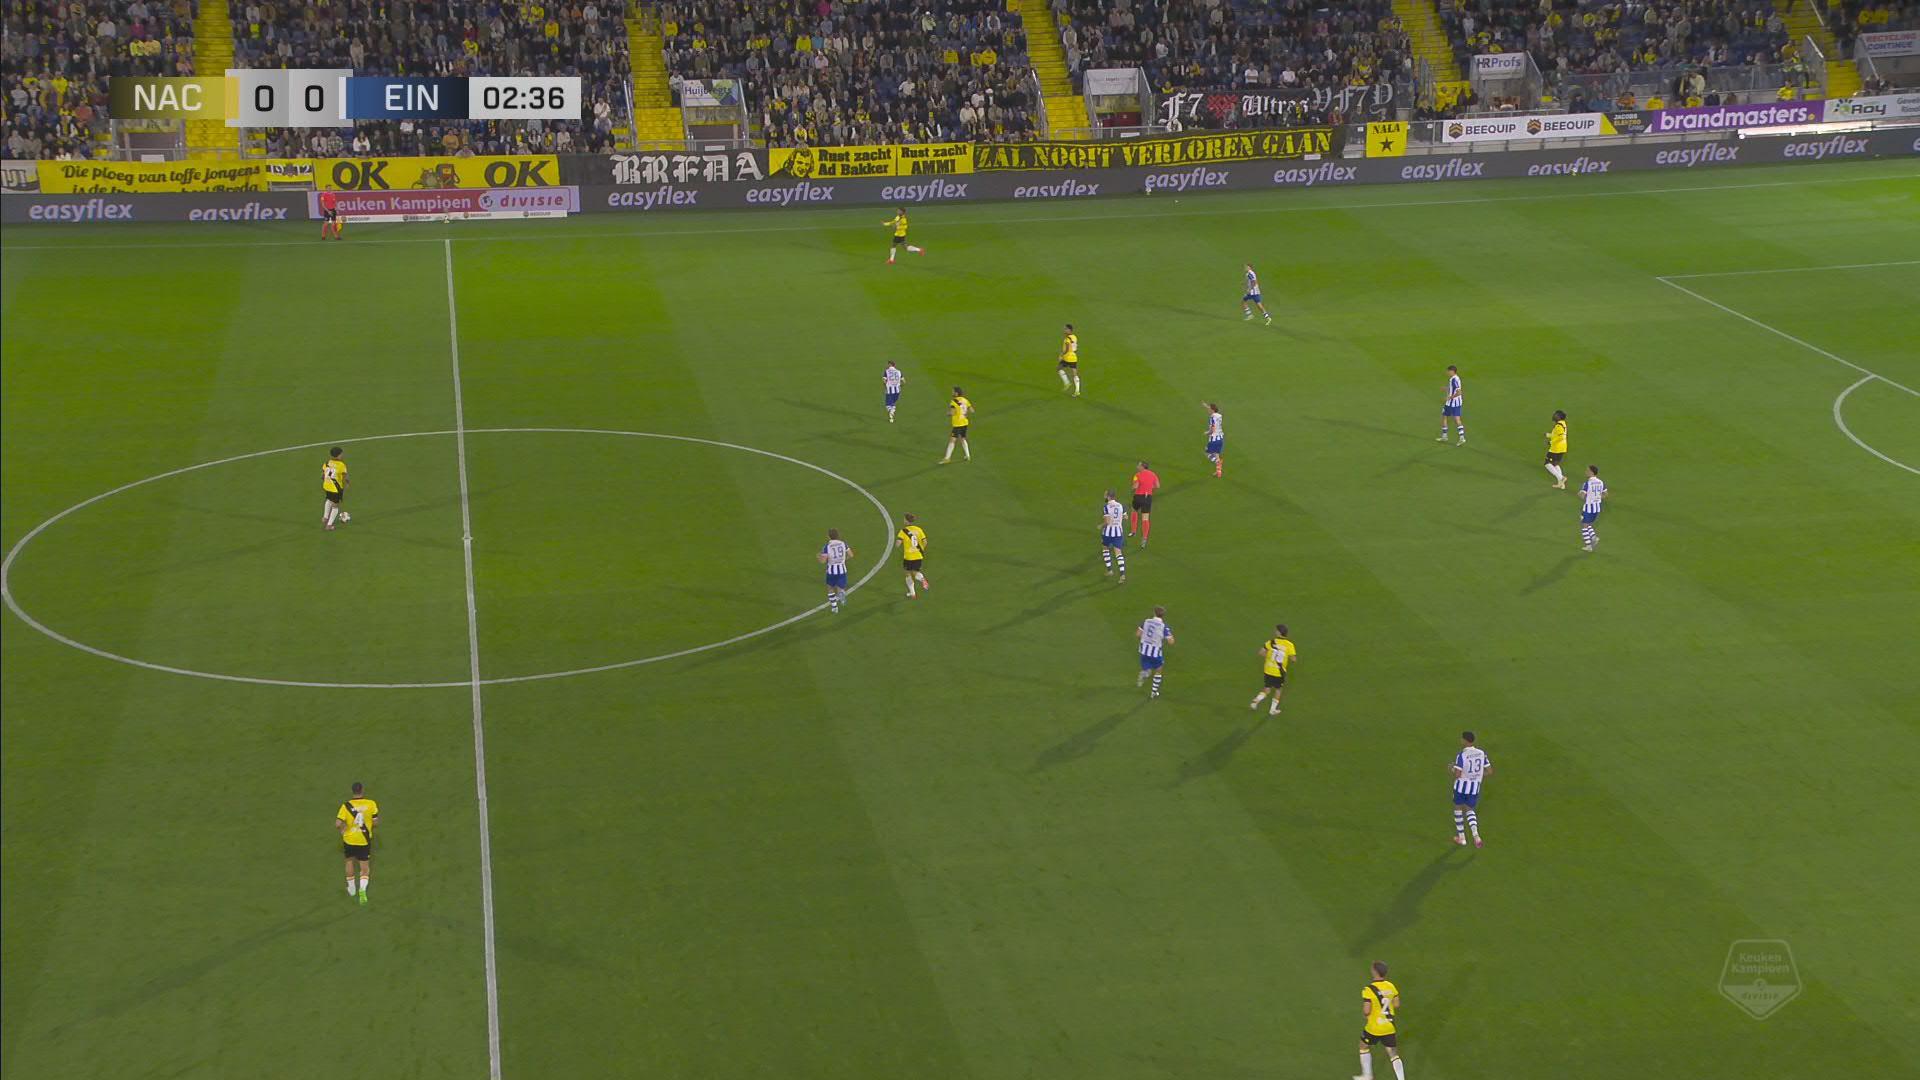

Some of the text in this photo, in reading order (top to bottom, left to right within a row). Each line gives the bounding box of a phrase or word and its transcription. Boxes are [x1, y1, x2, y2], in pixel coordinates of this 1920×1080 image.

[1851, 104, 1886, 115] Roy
[1372, 124, 1400, 134] NALA
[1465, 123, 1516, 135] BEEQUIP
[1543, 120, 1595, 131] BEEQUIP
[818, 147, 891, 162] Rust zacht
[901, 144, 967, 158] Rust zacht
[977, 146, 1027, 168] ZAL
[1122, 135, 1257, 167] VERLOREN
[1262, 132, 1332, 155] GAAN
[1655, 143, 1739, 167] easyflex
[1783, 136, 1869, 159] easyflex
[61, 165, 261, 185] Die ploeg van toffe jongens
[332, 161, 390, 190] OK
[484, 160, 551, 187] OK
[818, 162, 889, 176] Ad Bakker
[911, 158, 956, 175] AMMI
[1273, 163, 1357, 186] easyflex
[1402, 158, 1484, 180] easyflex
[1145, 168, 1229, 191] easyflex
[608, 185, 698, 210] easyflex
[746, 182, 834, 206] easyflex
[881, 179, 968, 202] easyflex
[29, 199, 132, 222] easyflex
[336, 197, 386, 211] euken
[391, 195, 471, 212] Kampioen
[831, 546, 844, 559] 19
[1467, 758, 1482, 773] 13
[1381, 997, 1391, 1015] 2
